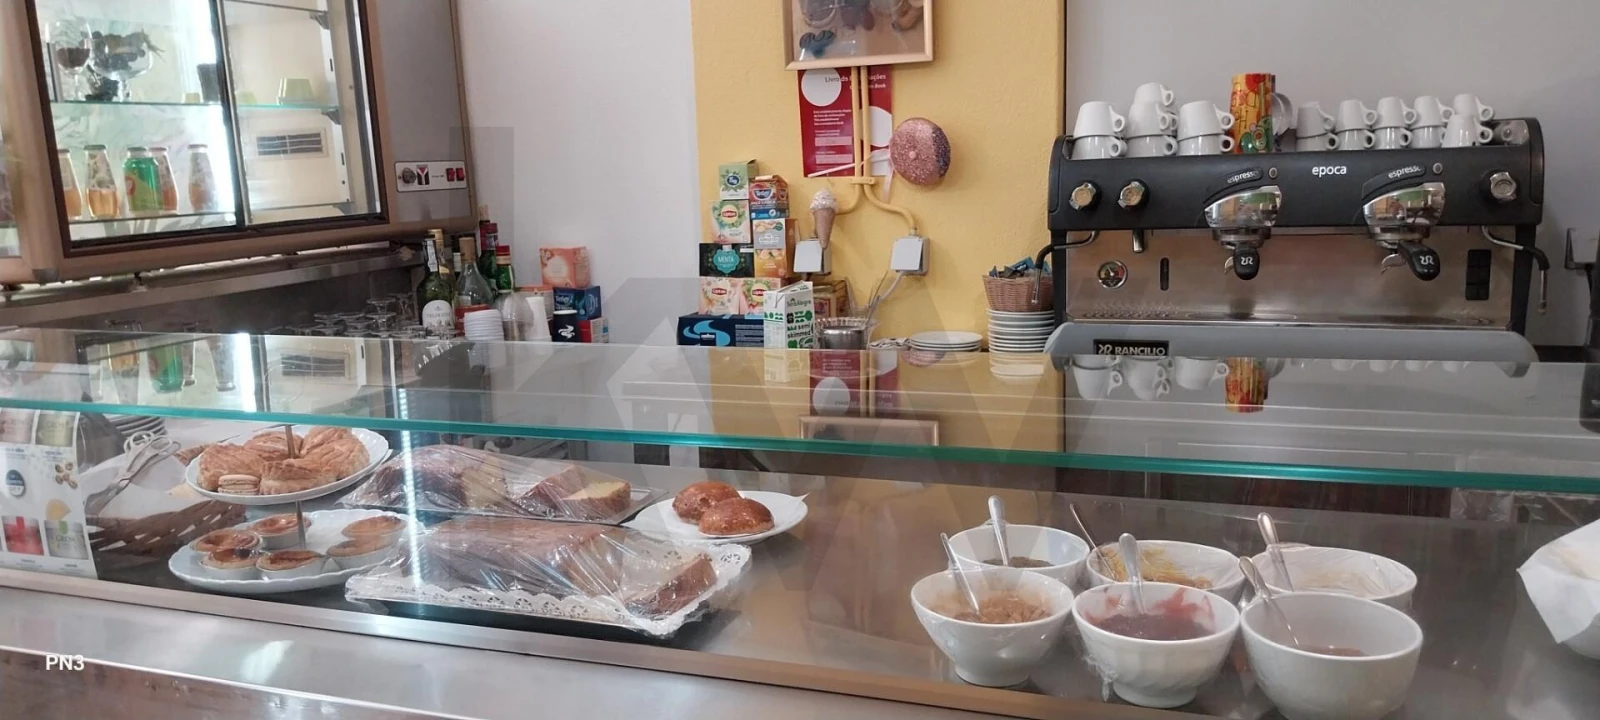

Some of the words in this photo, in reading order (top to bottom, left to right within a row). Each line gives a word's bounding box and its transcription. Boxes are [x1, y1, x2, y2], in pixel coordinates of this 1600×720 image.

[1311, 164, 1347, 178] epoca
[798, 322, 811, 330] semi
[787, 330, 811, 338] skimmed
[1115, 346, 1166, 356] RANCILIO
